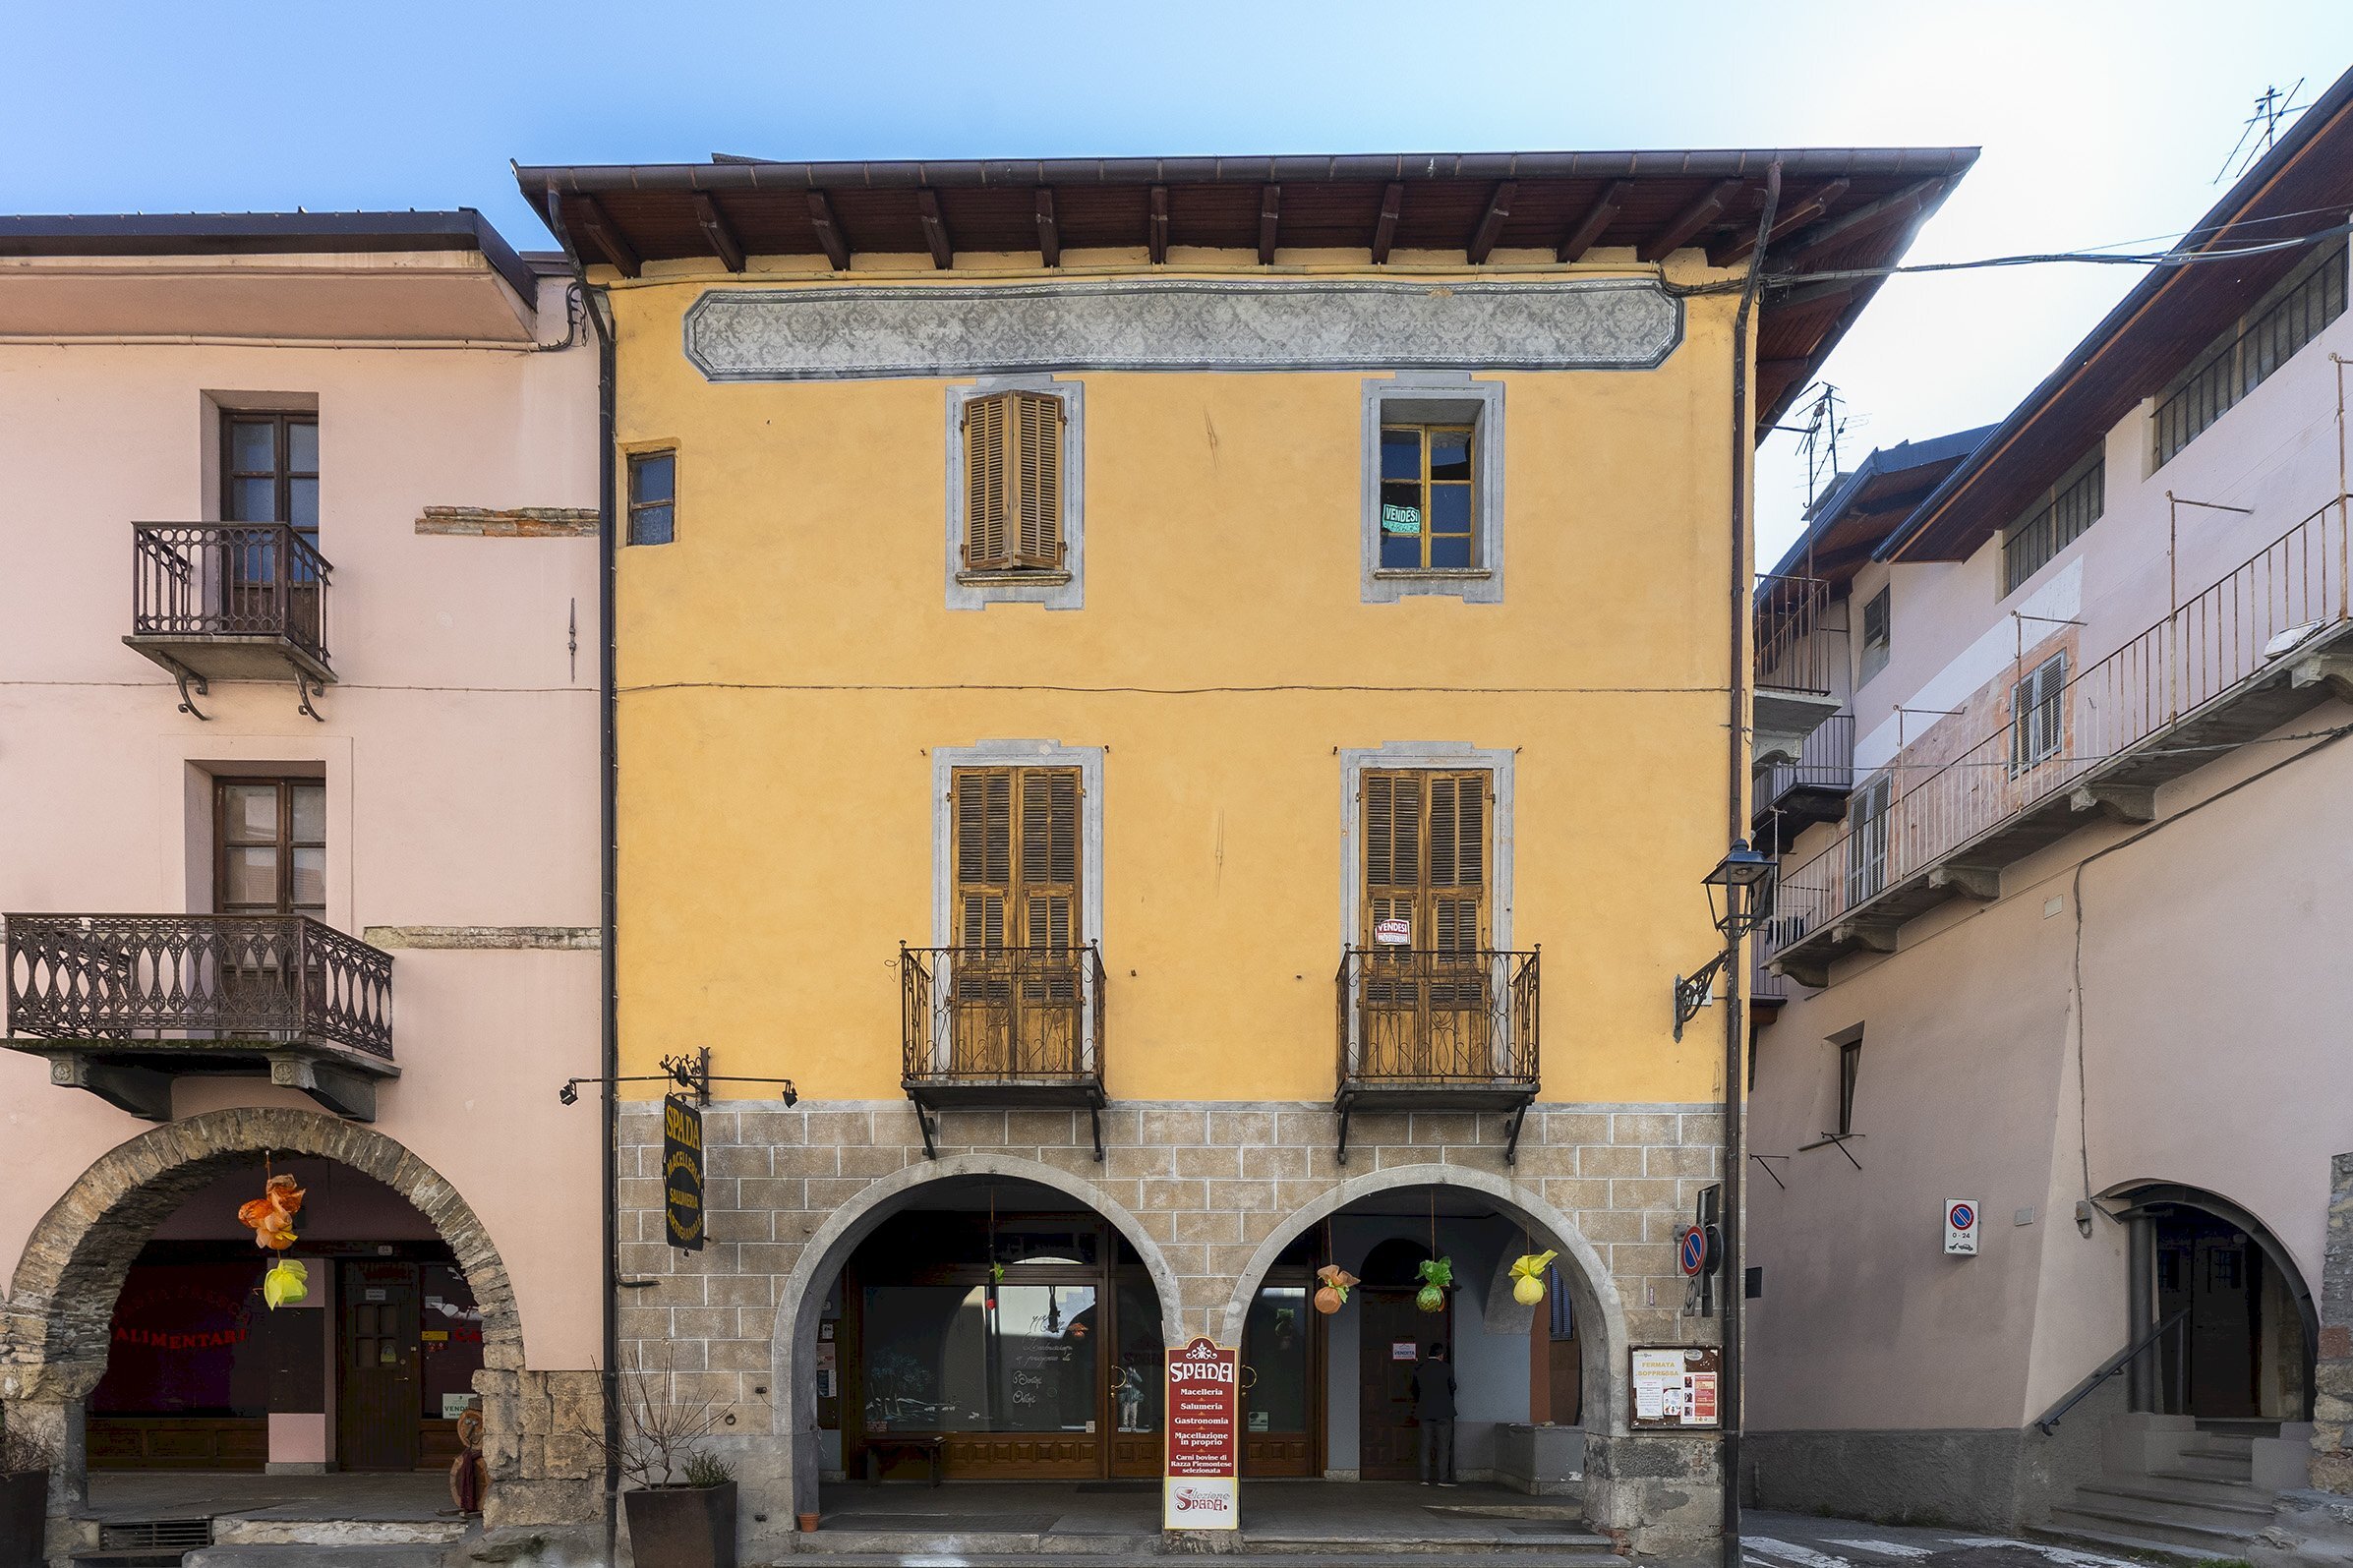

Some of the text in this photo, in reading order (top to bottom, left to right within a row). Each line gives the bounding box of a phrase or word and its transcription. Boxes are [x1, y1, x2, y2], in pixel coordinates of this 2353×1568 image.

[1385, 506, 1418, 523] VENDESI
[1378, 922, 1407, 932] VENDESI
[666, 1104, 701, 1151] SPADA
[667, 1150, 701, 1190] MACELLERIA
[669, 1188, 699, 1210] SALUMERIA
[667, 1207, 703, 1242] ARTIGIANALE
[114, 1326, 248, 1350] ALIMENTARI
[1169, 1362, 1234, 1383] SPADA
[1191, 1438, 1223, 1447] proprio
